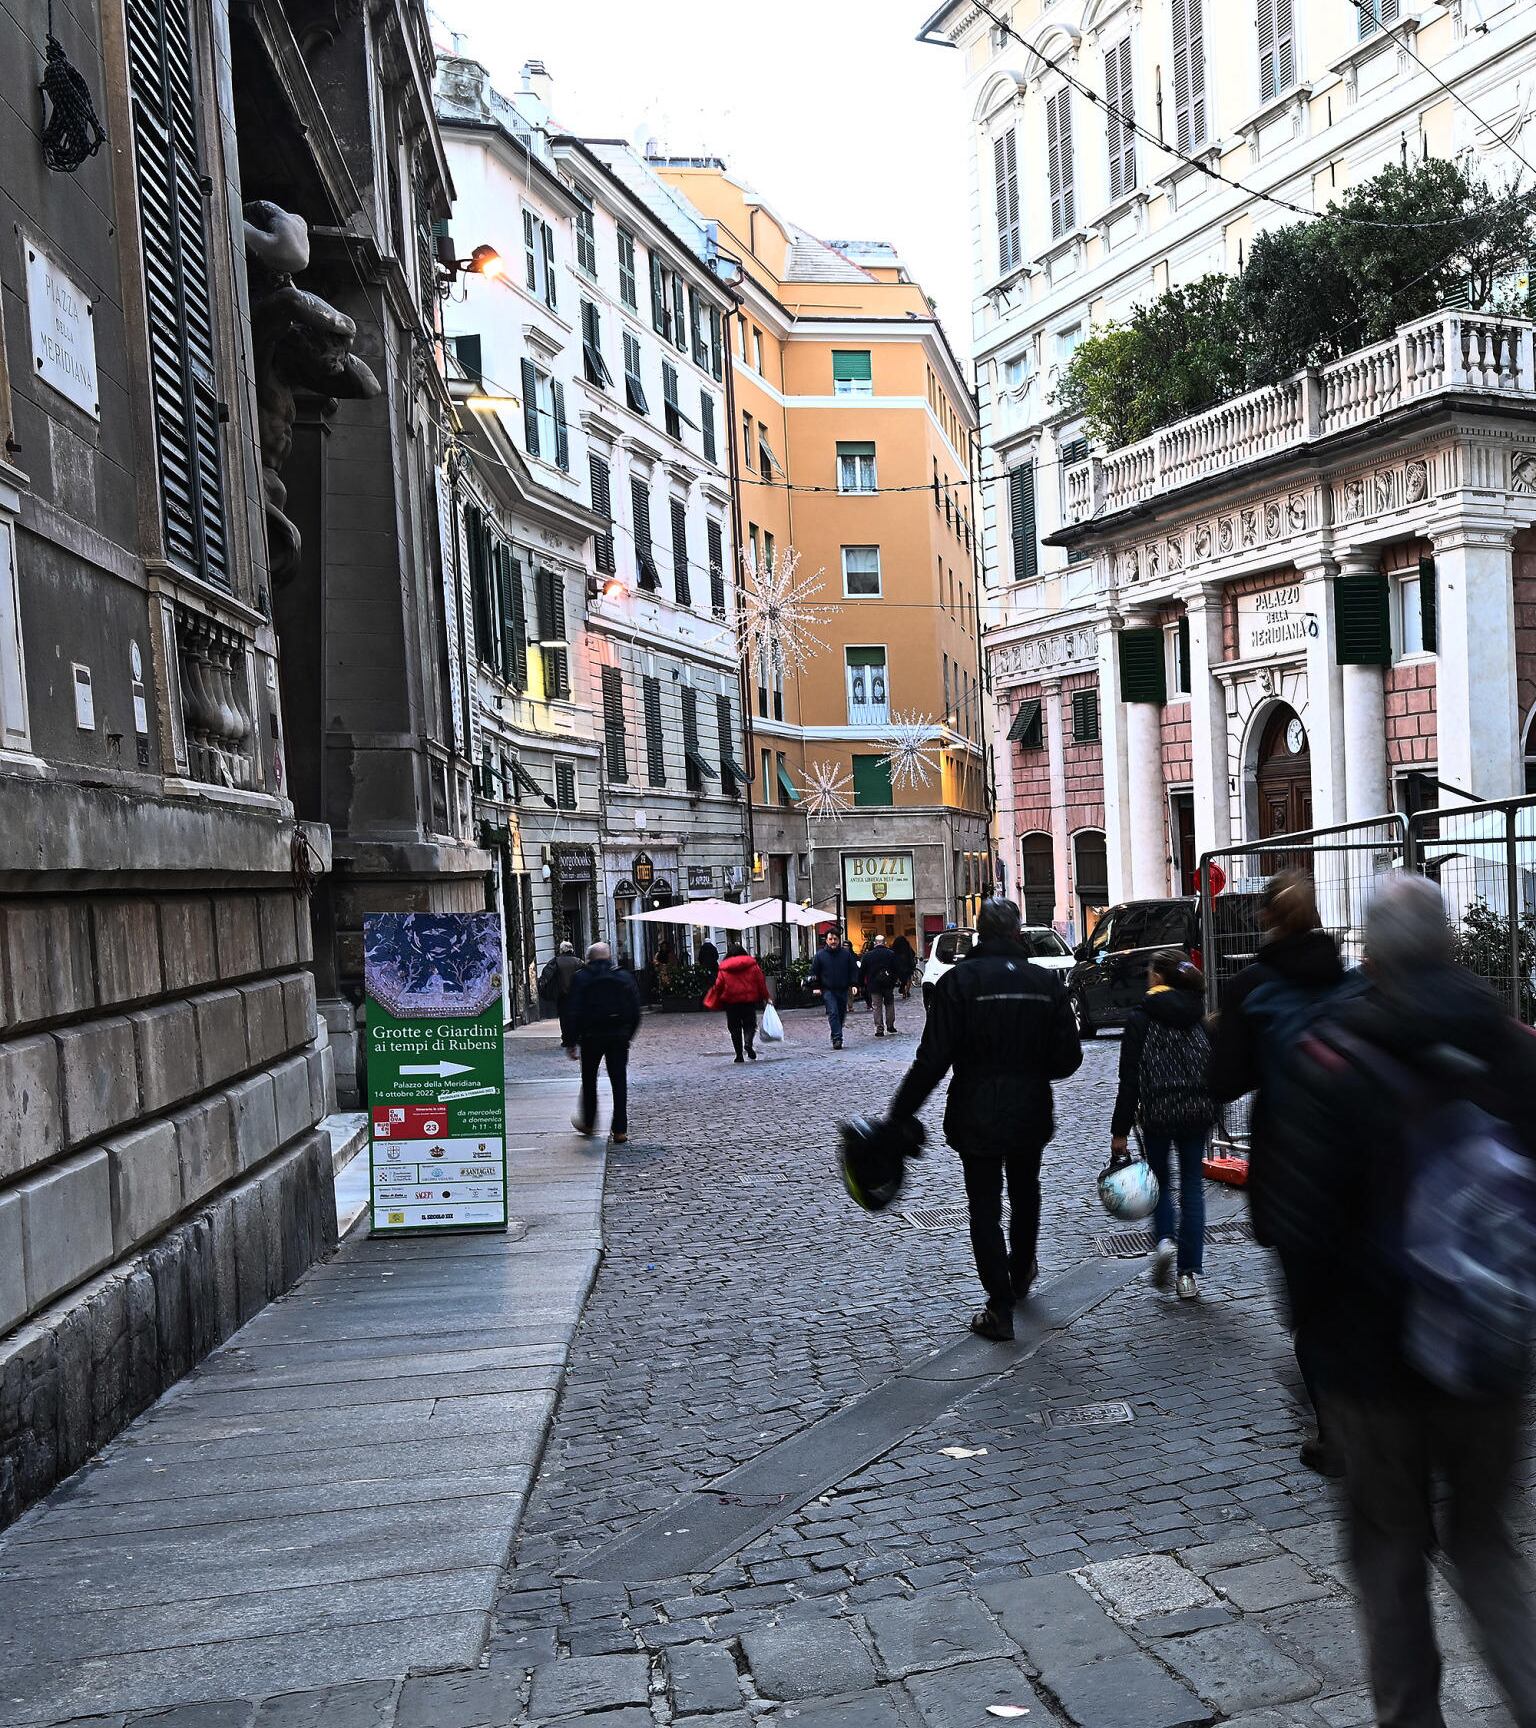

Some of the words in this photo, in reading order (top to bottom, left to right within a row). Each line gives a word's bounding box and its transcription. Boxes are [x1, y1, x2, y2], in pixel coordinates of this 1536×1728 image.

[45, 273, 79, 324] PIAZZA
[55, 316, 74, 344] DELLA
[40, 330, 93, 393] MERIDIANA
[1255, 586, 1300, 611] PALAZZO
[1266, 609, 1289, 625] DELLA
[1251, 620, 1307, 647] MERIDIANA
[852, 855, 905, 876] BOZZI
[372, 1025, 421, 1039] Grotte
[425, 1028, 433, 1038] e
[437, 1024, 498, 1038] Giardini
[374, 1041, 386, 1052] ai
[390, 1040, 428, 1054] tempi
[432, 1039, 445, 1051] di
[448, 1038, 497, 1051] Rubens
[393, 1081, 422, 1089] Palazzo
[423, 1080, 442, 1088] della
[374, 1090, 384, 1098] 14
[385, 1089, 414, 1098] ottobre
[415, 1089, 434, 1097] 2022
[467, 1108, 502, 1116] mercoledì
[494, 1122, 502, 1130] 18
